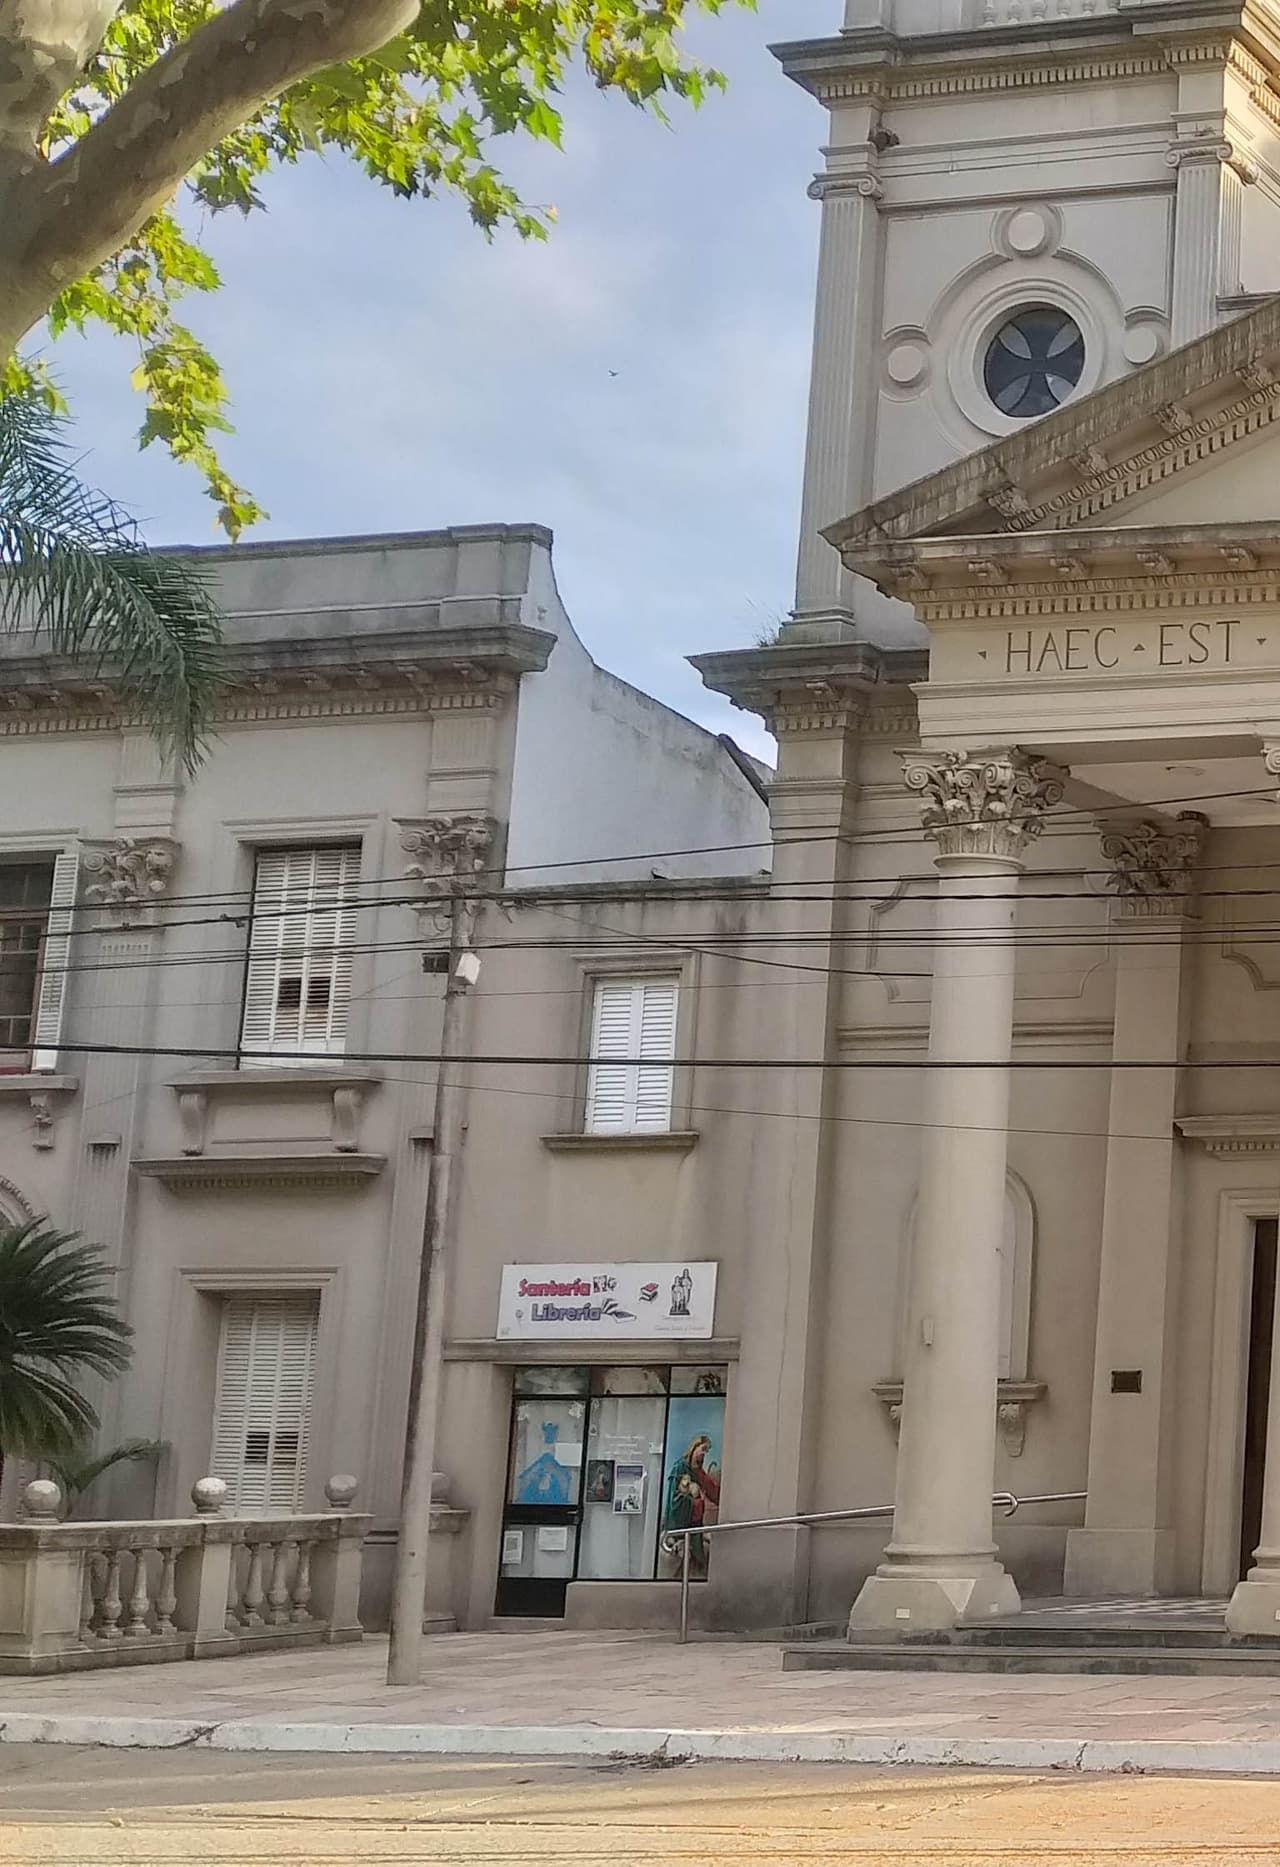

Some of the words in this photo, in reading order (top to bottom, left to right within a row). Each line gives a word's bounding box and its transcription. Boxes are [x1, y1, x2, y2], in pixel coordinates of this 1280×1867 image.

[1006, 627, 1119, 672] HAEC
[1159, 620, 1240, 665] EST
[519, 1278, 591, 1297] Santería
[531, 1302, 601, 1322] Librería
